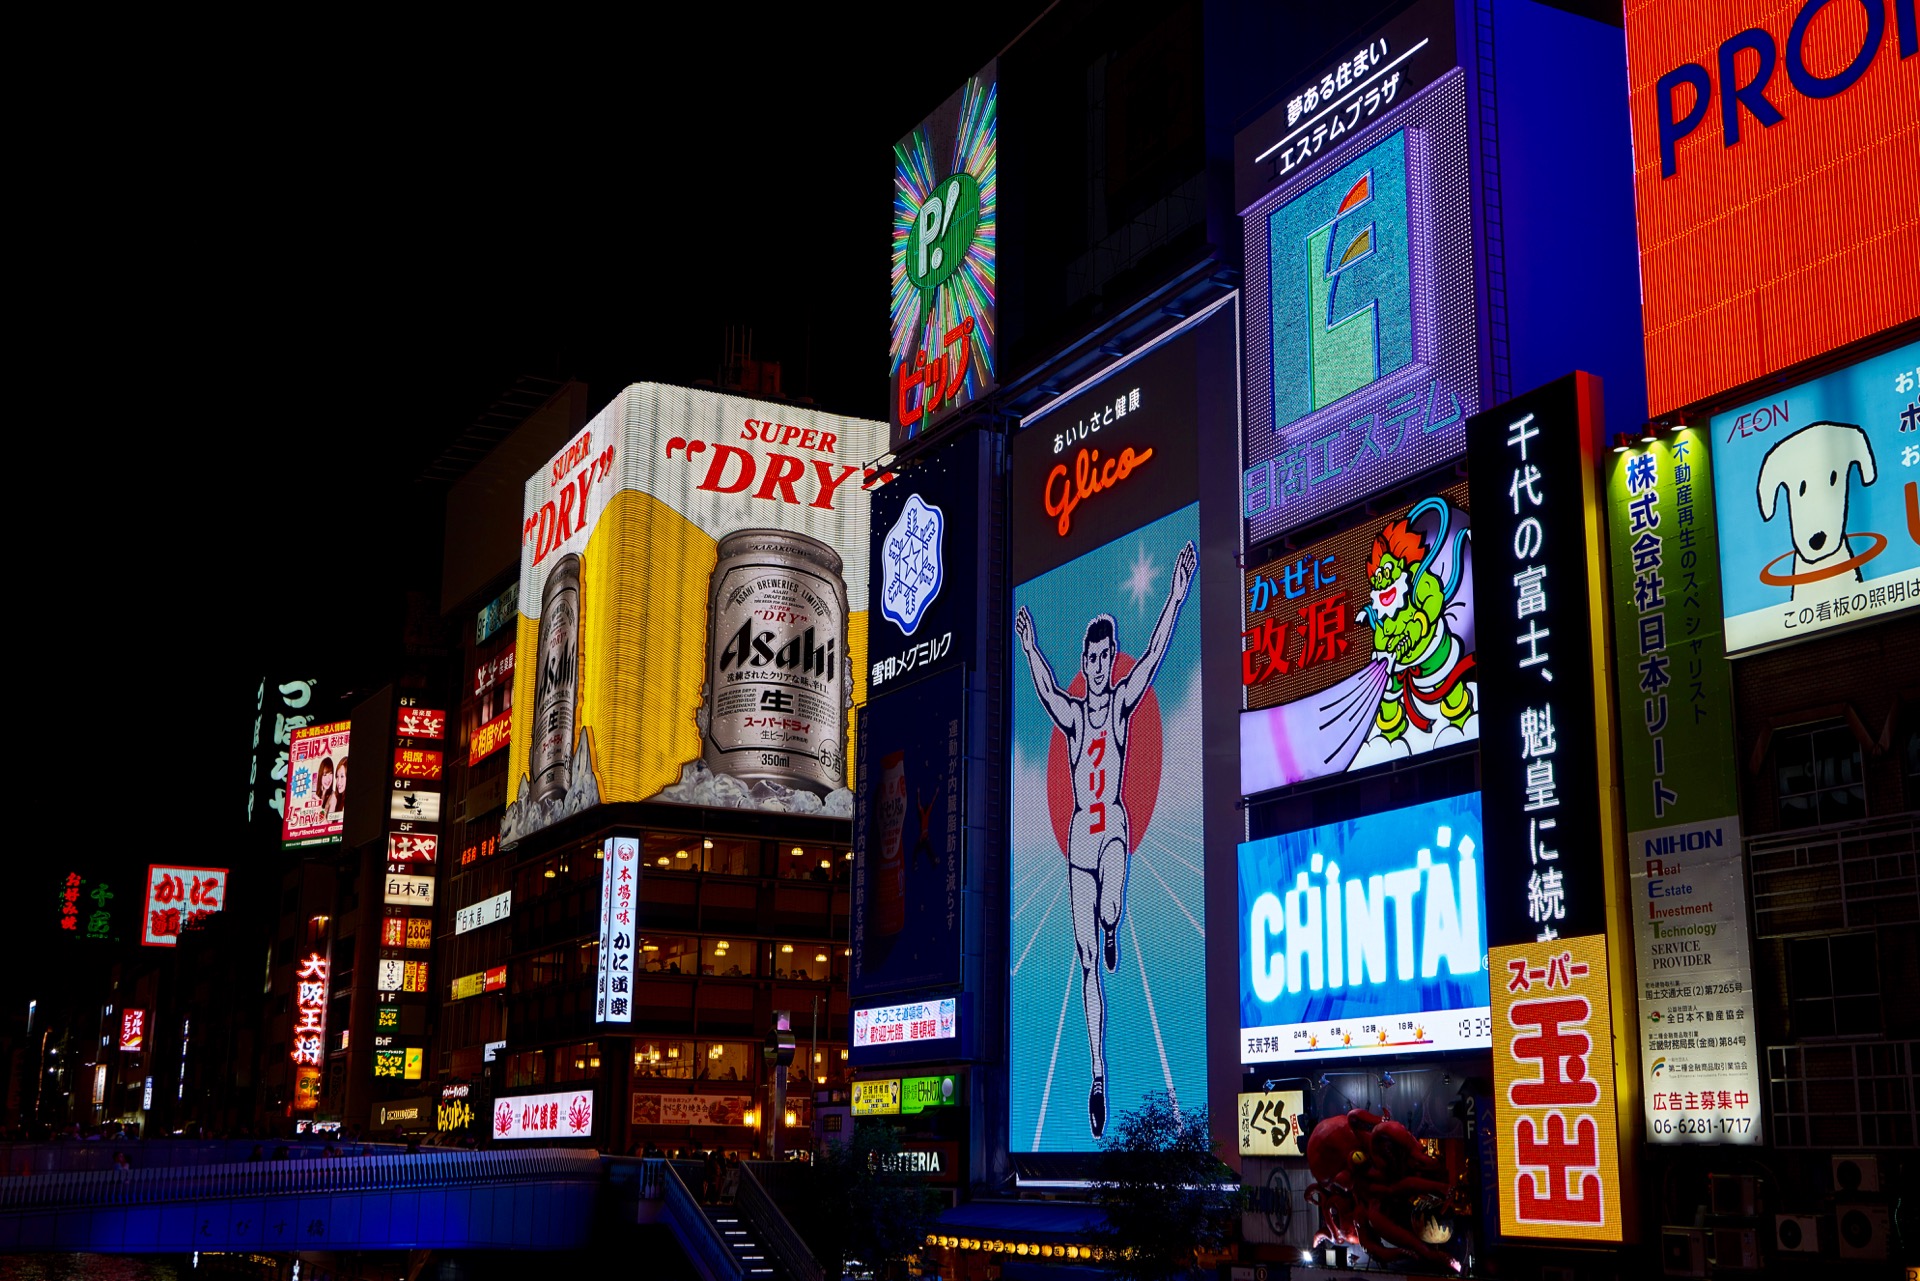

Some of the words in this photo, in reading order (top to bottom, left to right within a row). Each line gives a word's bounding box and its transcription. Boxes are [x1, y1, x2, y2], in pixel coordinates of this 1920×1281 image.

[1287, 38, 1388, 127] 夢ある住まい
[1280, 71, 1400, 175] エステムプラザ
[899, 315, 975, 427] ピップ
[1053, 388, 1141, 454] おいしさと健康
[740, 418, 838, 454] SUPER
[1243, 380, 1462, 518] 日商エステム
[551, 431, 591, 487] SUPER
[1250, 553, 1336, 613] かぜに
[1672, 440, 1707, 725] 不動産再生のスペシャリスト
[736, 586, 755, 606] ASAHI
[757, 579, 799, 594] BREWERIES
[801, 589, 824, 617] LIMITED
[1784, 577, 1920, 629] この看板の照明は
[1242, 591, 1346, 685] 改源
[1626, 451, 1677, 818] 株式会社日本リート
[720, 616, 835, 683] Asahi
[872, 632, 951, 686] 雪印メグミルク
[760, 689, 795, 714] 生
[744, 717, 811, 734] スーパードライ
[296, 738, 332, 760] 高収入
[403, 751, 423, 763] 相席
[761, 753, 790, 767] 350ml
[820, 748, 842, 775] お酒
[395, 762, 442, 777] ダイニング
[1087, 730, 1107, 834] グリコ
[1645, 829, 1723, 857] NIHON
[1646, 859, 1681, 878] Real
[154, 873, 219, 907] かに
[388, 879, 430, 898] 白木屋
[616, 865, 632, 926] 本場の味
[1648, 880, 1692, 898] Estate
[462, 907, 482, 931] 白木屋
[1250, 826, 1481, 1004] CHINTAI
[1649, 901, 1713, 919] Investment
[407, 926, 431, 940] 280円
[1648, 920, 1717, 939] Technology
[1651, 940, 1700, 956] SERVICE
[1507, 951, 1589, 992] スーパー
[1652, 953, 1712, 970] PROVIDER
[291, 953, 327, 1065] 大阪王将
[380, 1011, 397, 1020] びっくり
[875, 1005, 931, 1024] ようこそ道頓堀へ
[1667, 1009, 1744, 1024] 全日本不動産協会
[131, 1010, 144, 1036] ツルハ
[910, 1019, 936, 1039] 道頓堀
[1293, 1030, 1307, 1039] 24時
[1330, 1027, 1341, 1036] 6時
[1362, 1025, 1376, 1033] 12時
[1398, 1021, 1413, 1030] 18時
[1248, 1036, 1279, 1054] 天気予報
[375, 1066, 403, 1077] ドンキー
[377, 1055, 402, 1067] びっくり
[1668, 1061, 1748, 1073] 第二種金融商品取引業協会
[1507, 995, 1605, 1227] 玉出
[1653, 1090, 1749, 1111] 広告主募集中
[437, 1099, 475, 1132] びっくりドンキー
[1250, 1100, 1291, 1147] くくる
[1654, 1117, 1751, 1134] 06-6281-1717
